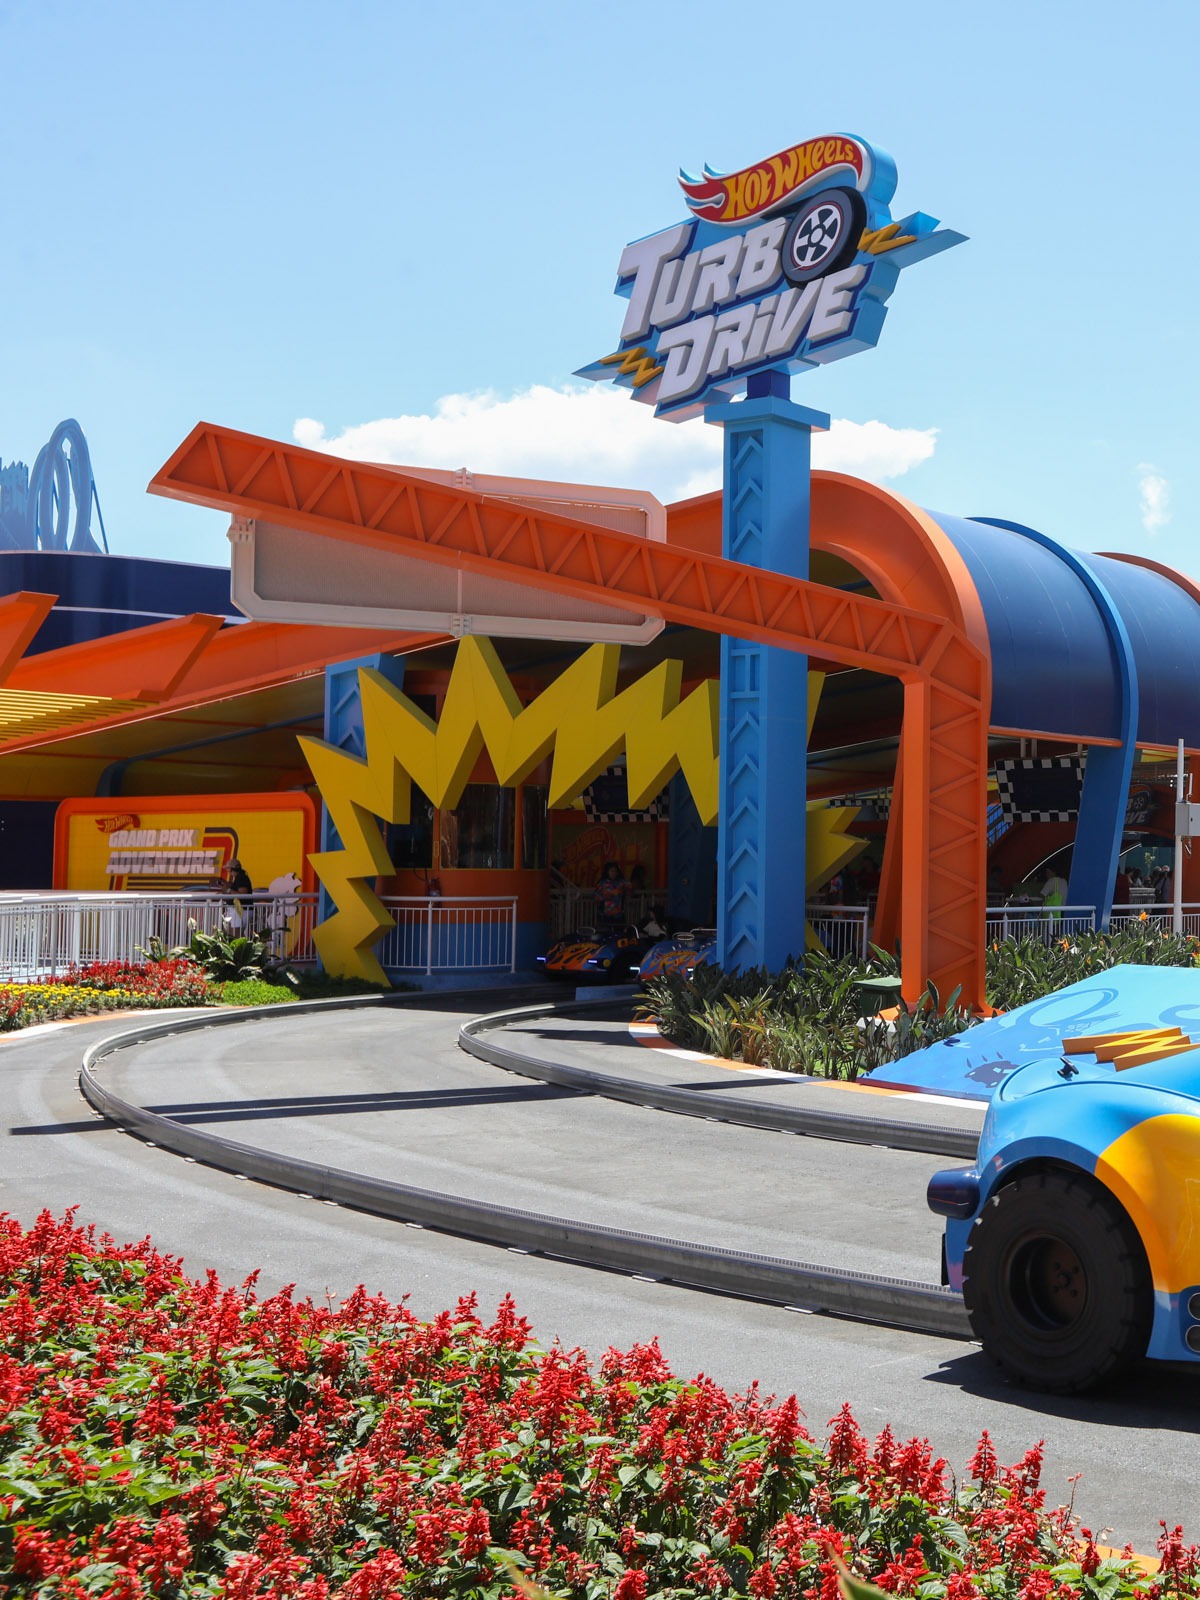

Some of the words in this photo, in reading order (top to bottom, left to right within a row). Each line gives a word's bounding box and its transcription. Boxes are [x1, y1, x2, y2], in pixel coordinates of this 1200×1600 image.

[109, 829, 156, 848] GRAND
[159, 829, 195, 848] PRIX
[106, 850, 217, 874] ADVENTURE
